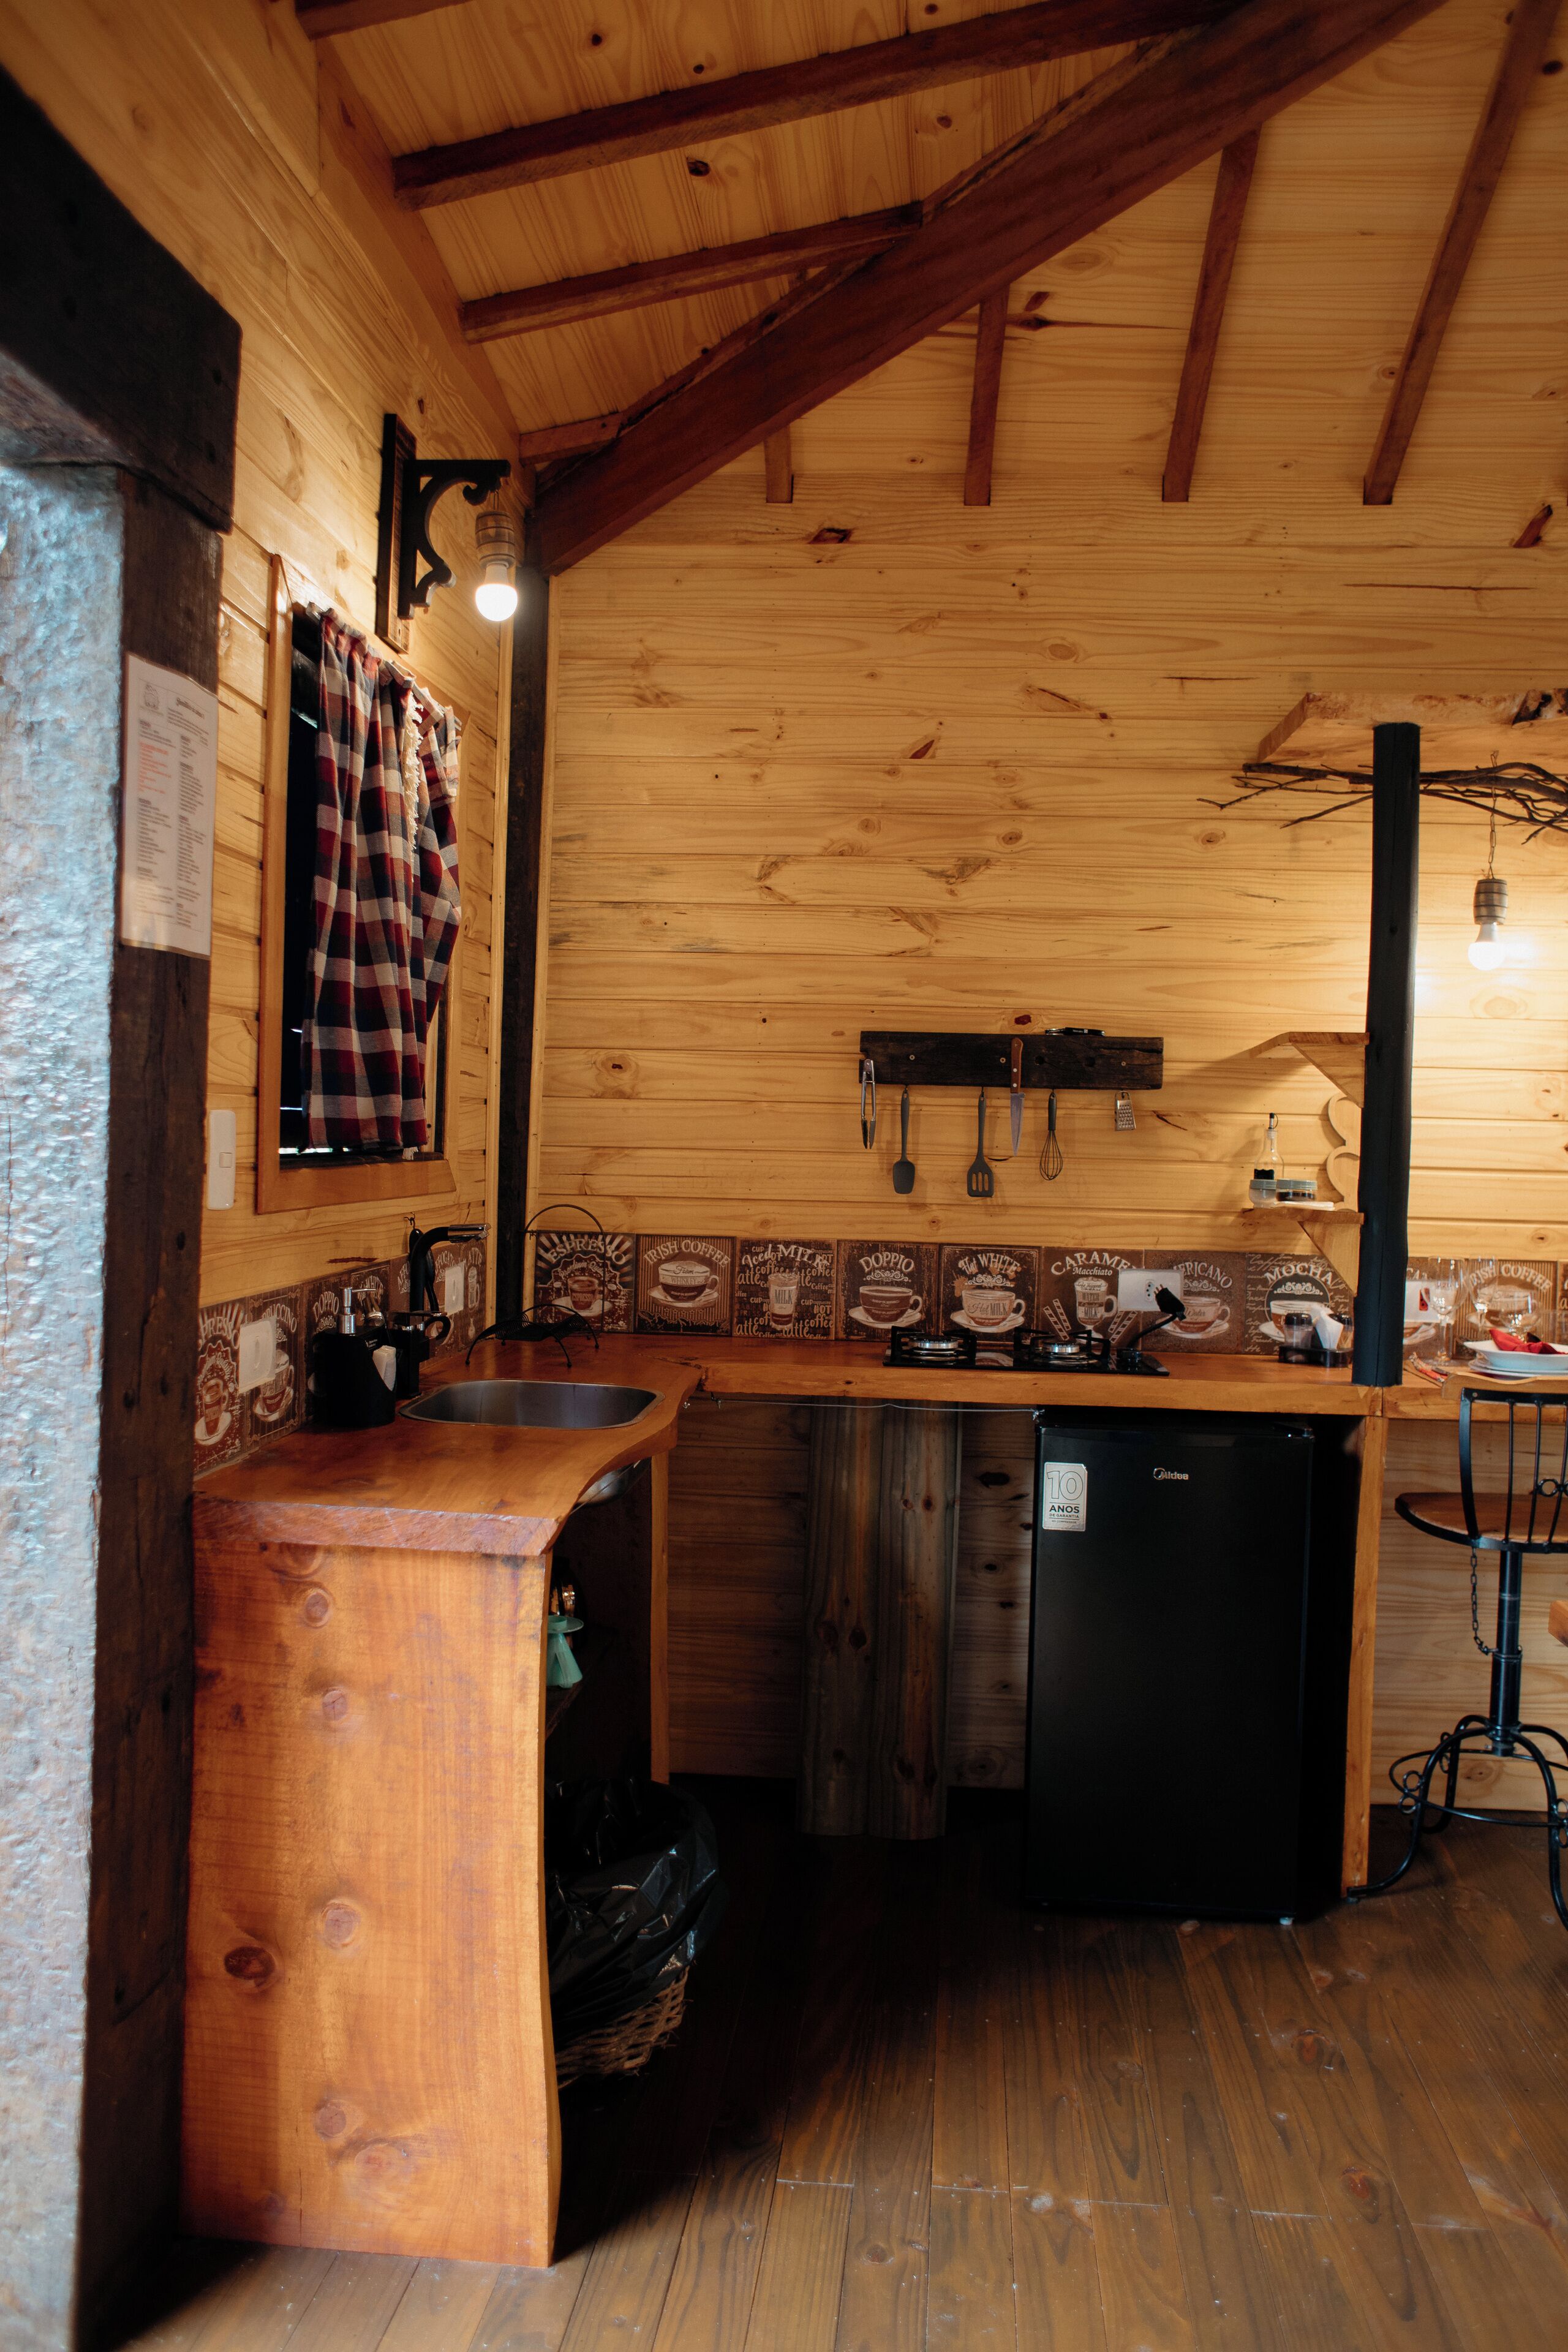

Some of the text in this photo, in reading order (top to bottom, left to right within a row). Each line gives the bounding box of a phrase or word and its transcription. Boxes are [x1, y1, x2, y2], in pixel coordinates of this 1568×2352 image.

[548, 1238, 625, 1264] ESPRESSO
[644, 1240, 730, 1267] IRISH COFFEE
[777, 1245, 830, 1272] MILK
[859, 1252, 914, 1272] DOPPIO
[977, 1253, 1020, 1275] WHITE
[1051, 1251, 1137, 1275] CARAME
[1072, 1267, 1112, 1276] Macchiato
[1264, 1264, 1332, 1285] MOCHA
[1173, 1262, 1233, 1289] ERICANO
[1501, 1264, 1553, 1293] COFFEE
[313, 1291, 339, 1323] DOPPIO
[774, 1289, 794, 1304] MILK
[990, 1303, 1007, 1316] MILK
[1153, 1468, 1189, 1480] Midea
[1047, 1471, 1083, 1501] 10
[1049, 1505, 1080, 1513] ANOS
